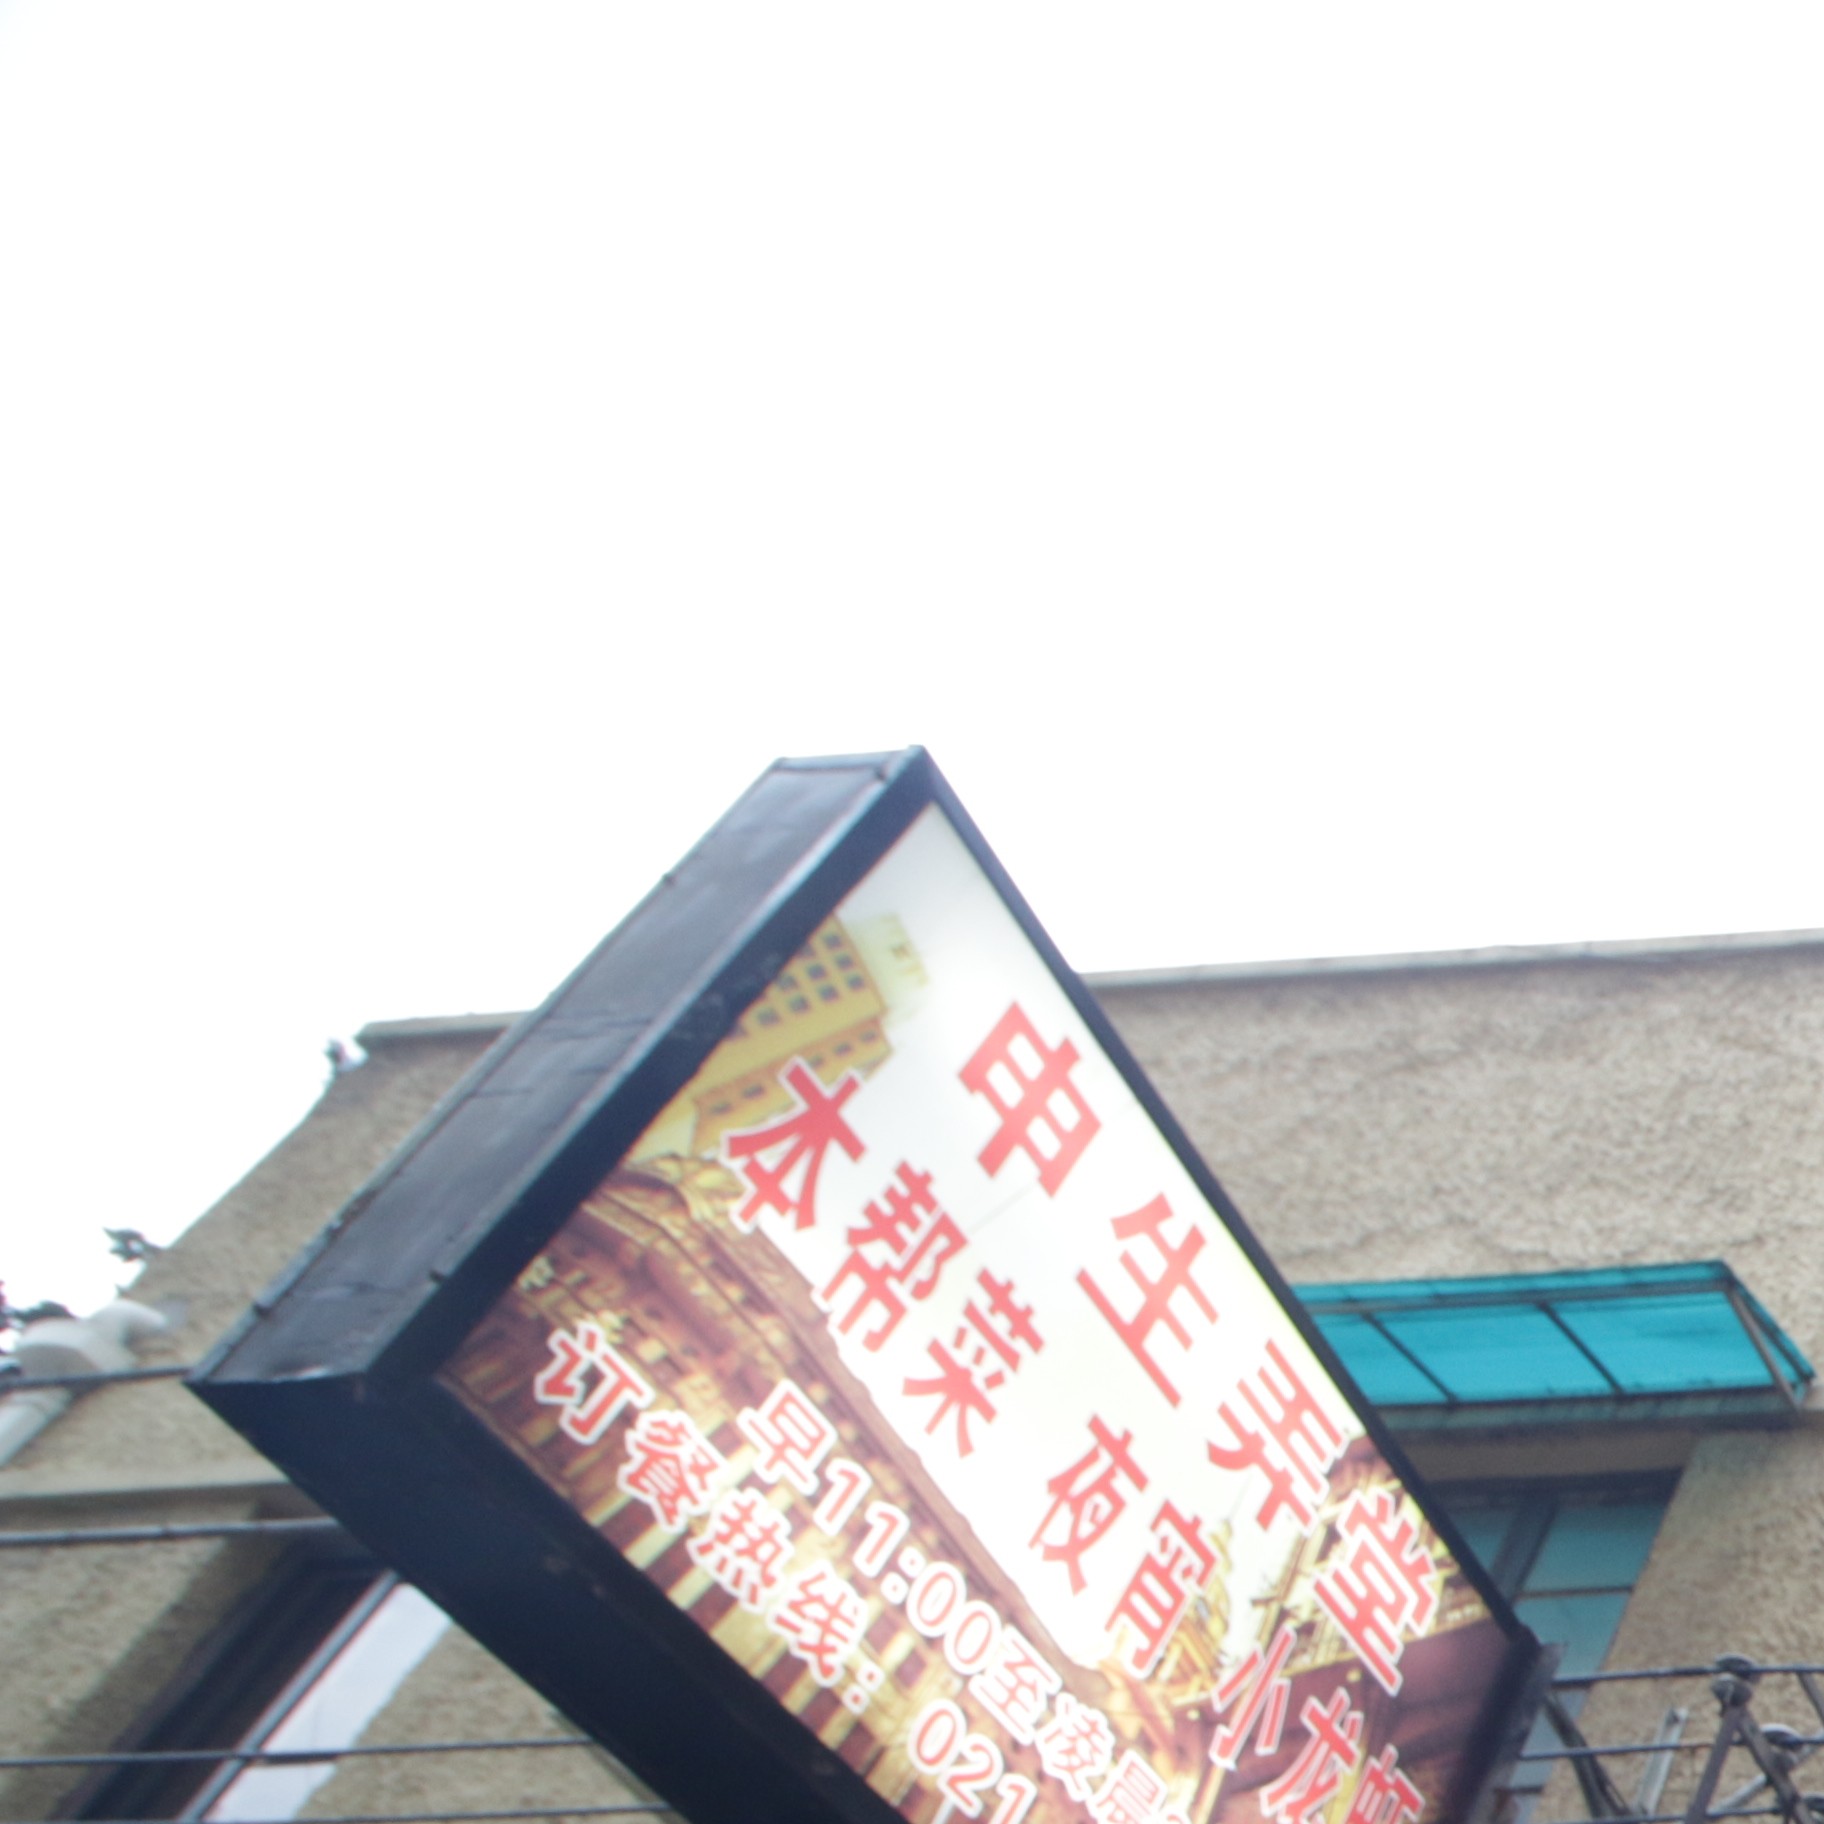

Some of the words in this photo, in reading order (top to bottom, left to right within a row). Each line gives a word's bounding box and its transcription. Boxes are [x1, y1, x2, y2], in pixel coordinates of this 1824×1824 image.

[722, 1058, 1044, 1457] 本帮菜
[1030, 1416, 1213, 1674] 夜宵
[959, 1002, 1436, 1692] 申生弄堂
